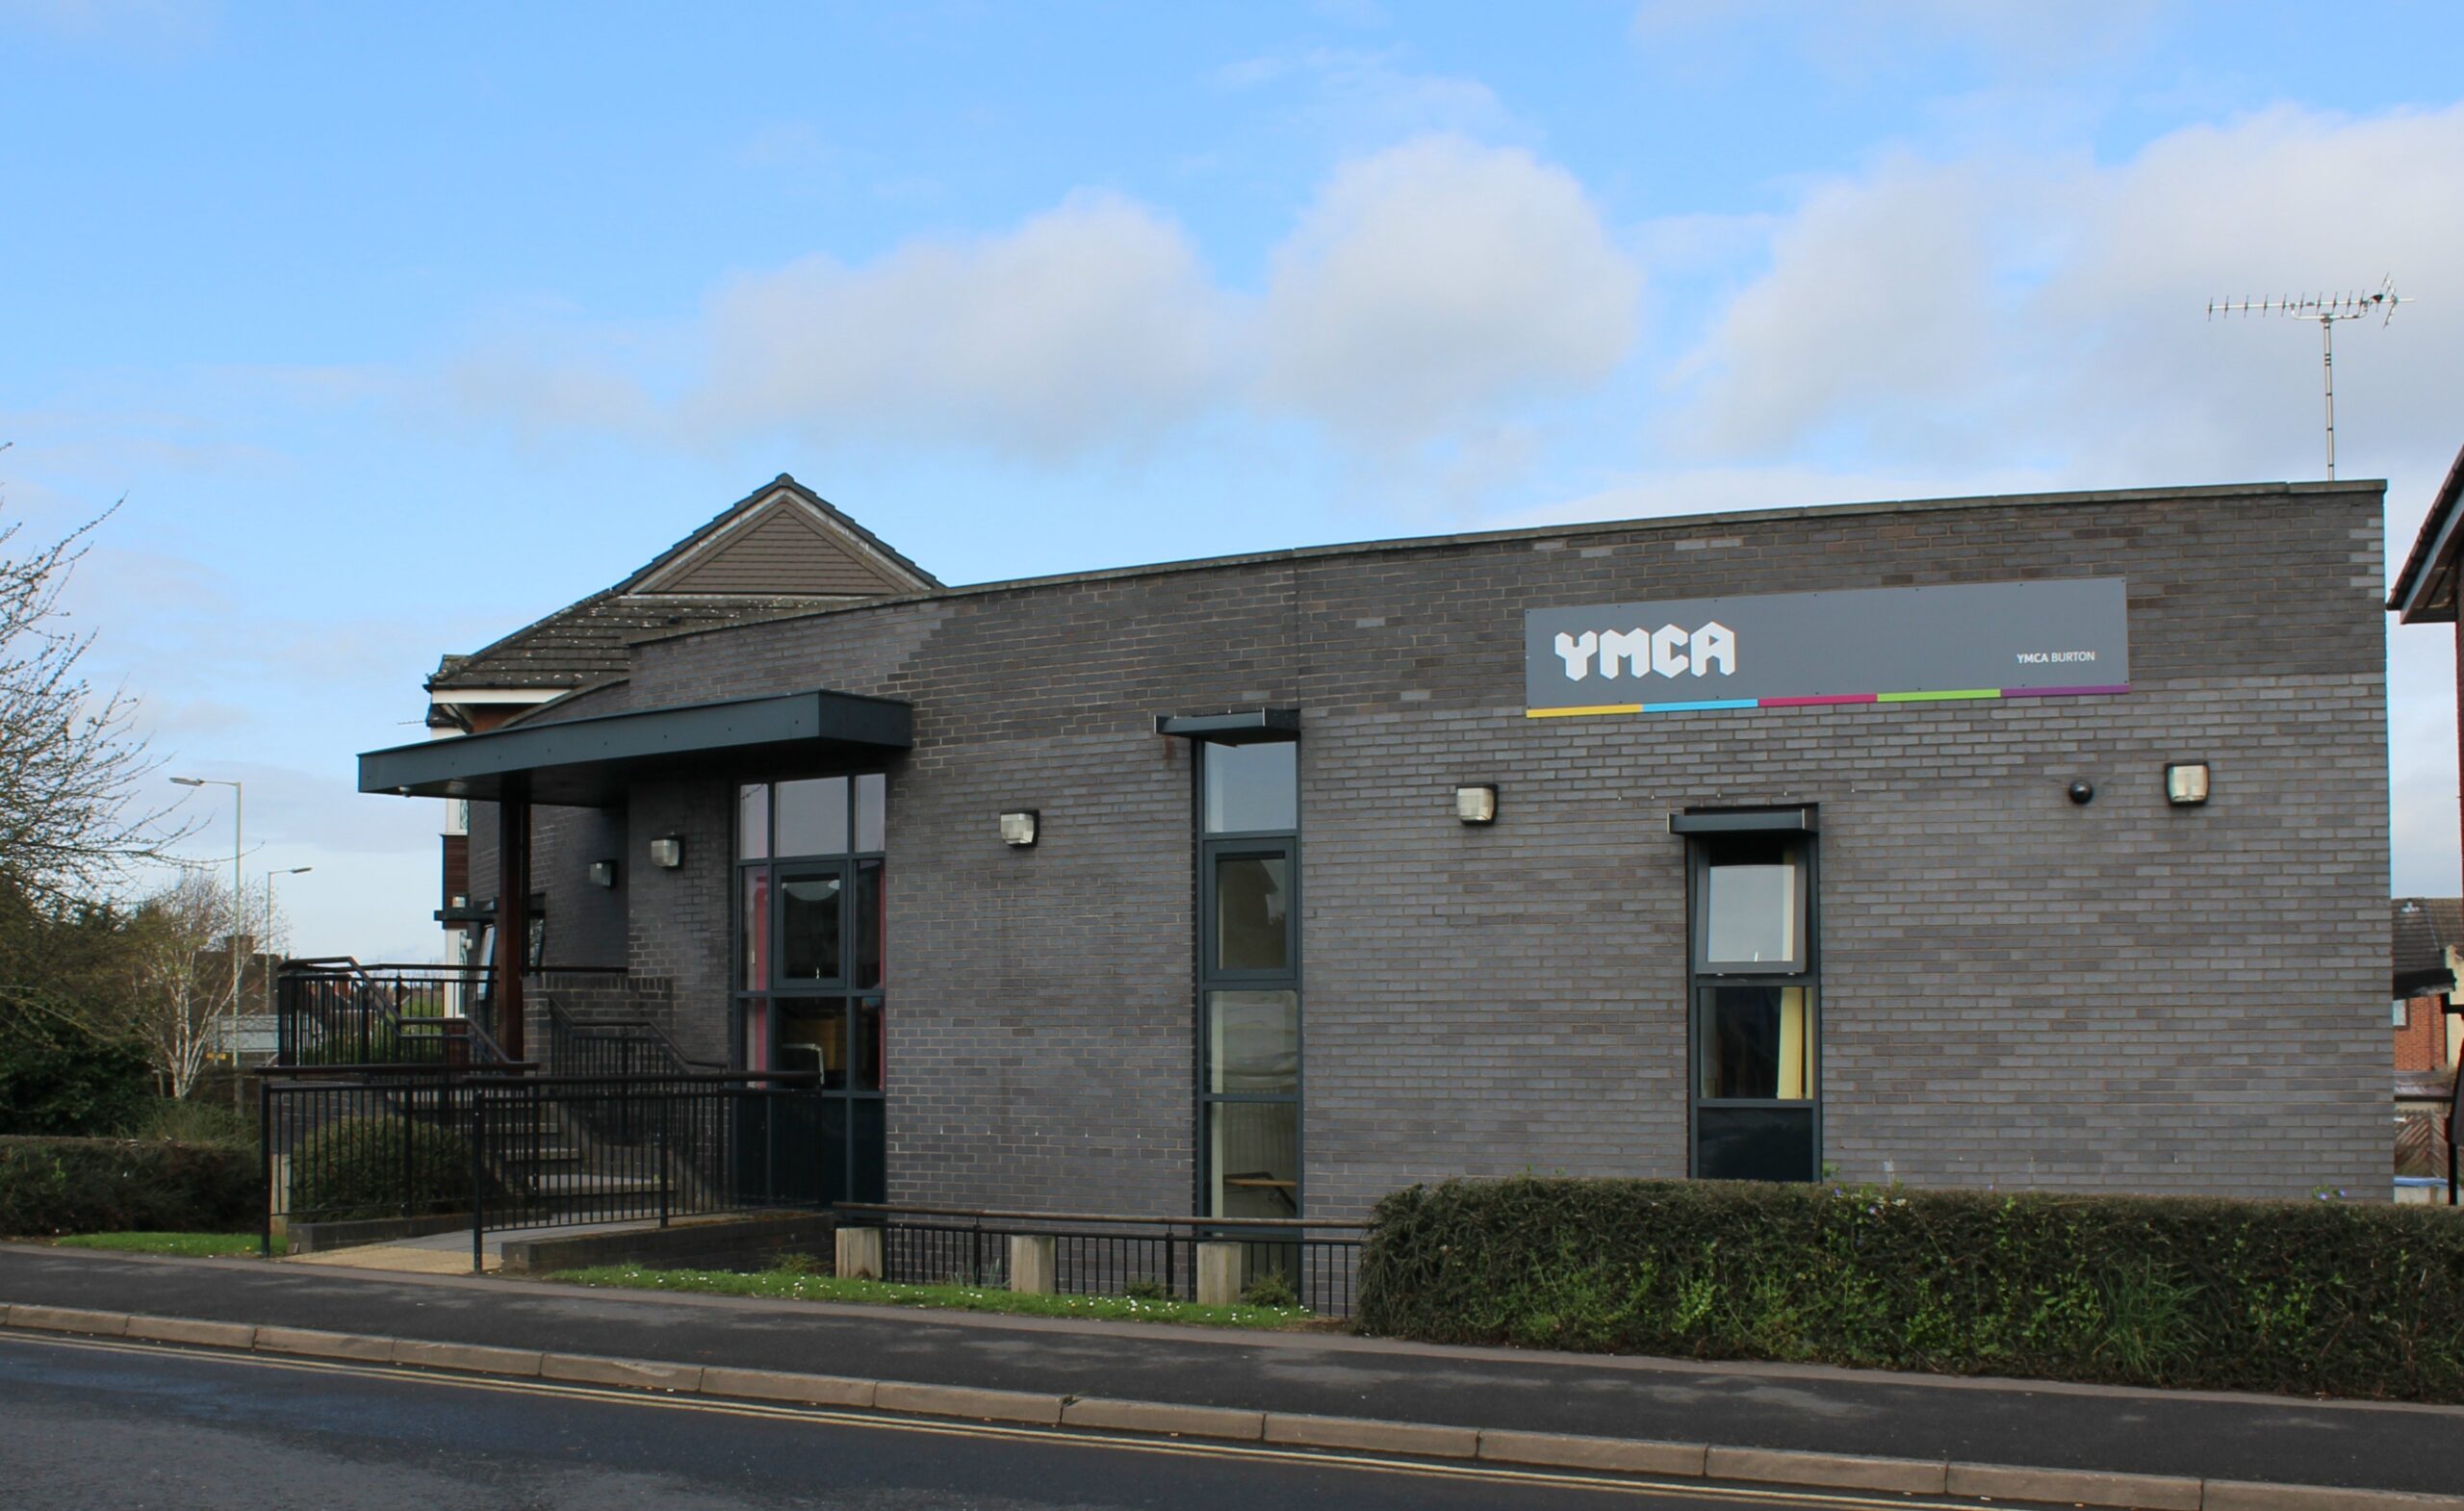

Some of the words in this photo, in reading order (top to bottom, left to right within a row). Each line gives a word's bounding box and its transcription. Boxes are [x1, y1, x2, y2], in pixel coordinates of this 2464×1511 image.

[1554, 621, 1735, 681] YMCA
[2016, 653, 2049, 664] YMCA
[2051, 651, 2095, 662] BURTON
